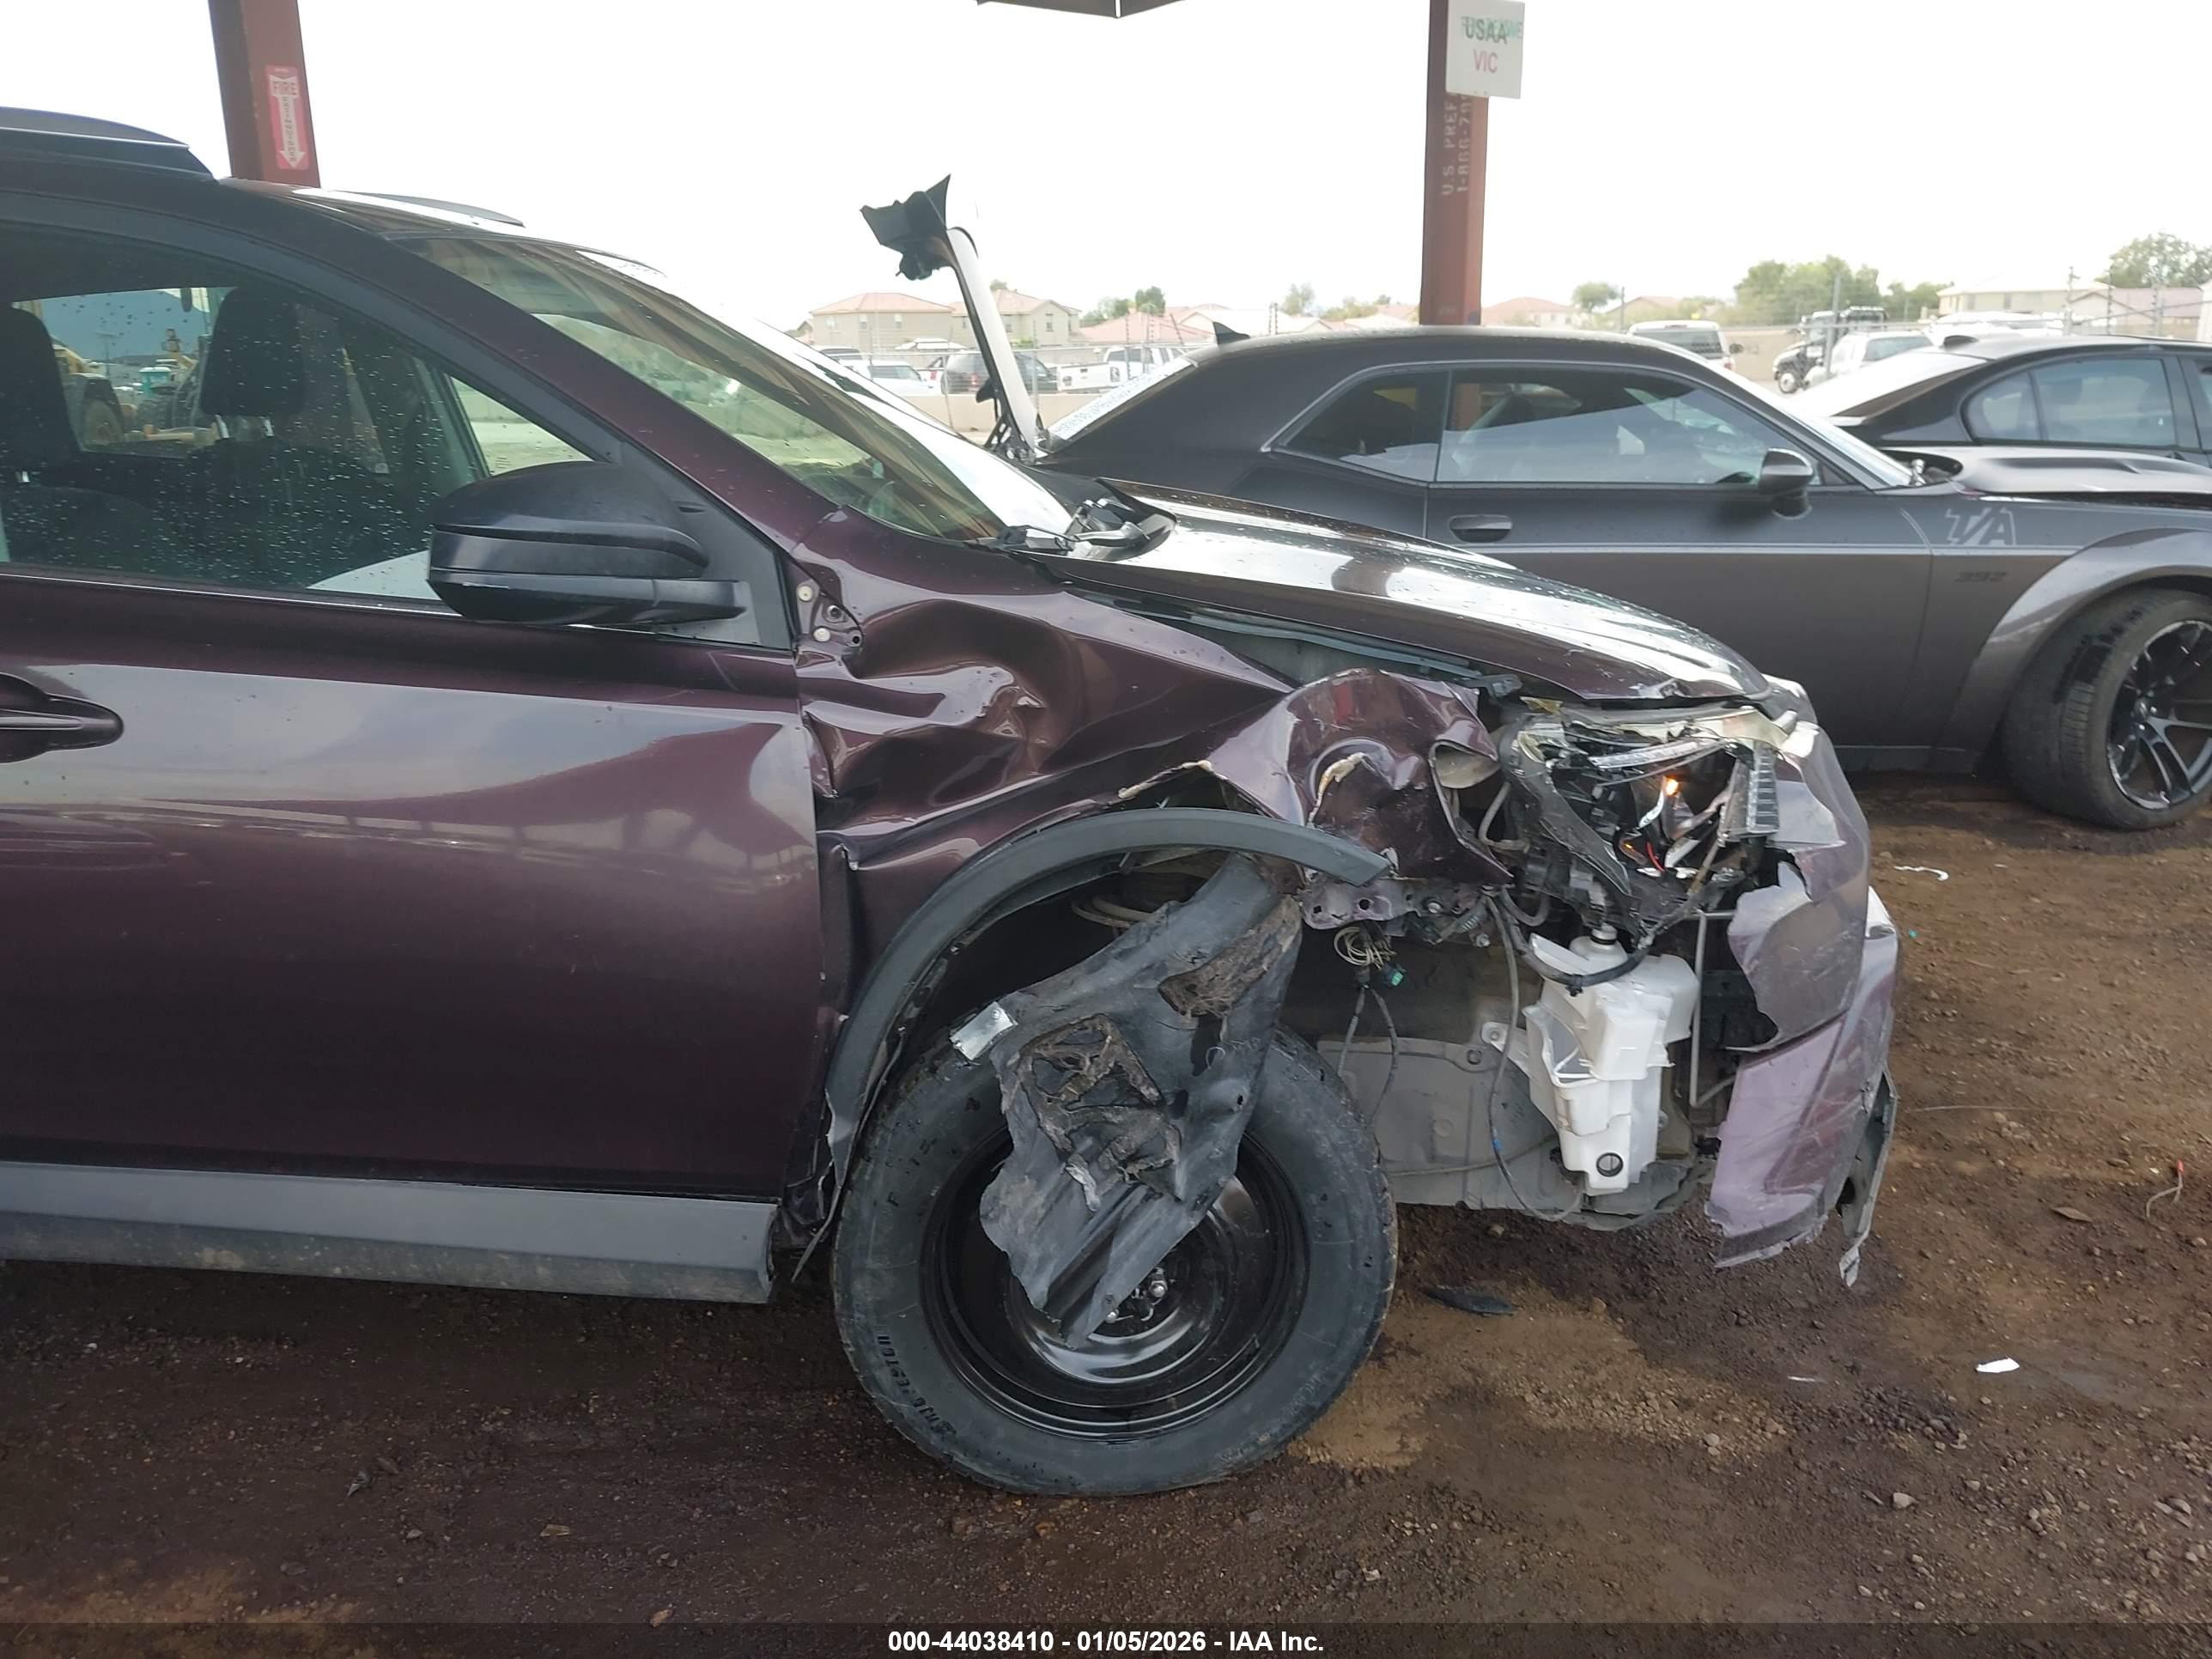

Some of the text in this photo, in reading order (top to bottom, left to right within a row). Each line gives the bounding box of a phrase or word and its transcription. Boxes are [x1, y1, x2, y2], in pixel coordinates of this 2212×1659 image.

[1465, 18, 1508, 45] USAA
[1473, 48, 1499, 74] VIC
[272, 80, 298, 96] FIRE
[1443, 93, 1457, 149] PREF
[1954, 571, 2007, 583] 392
